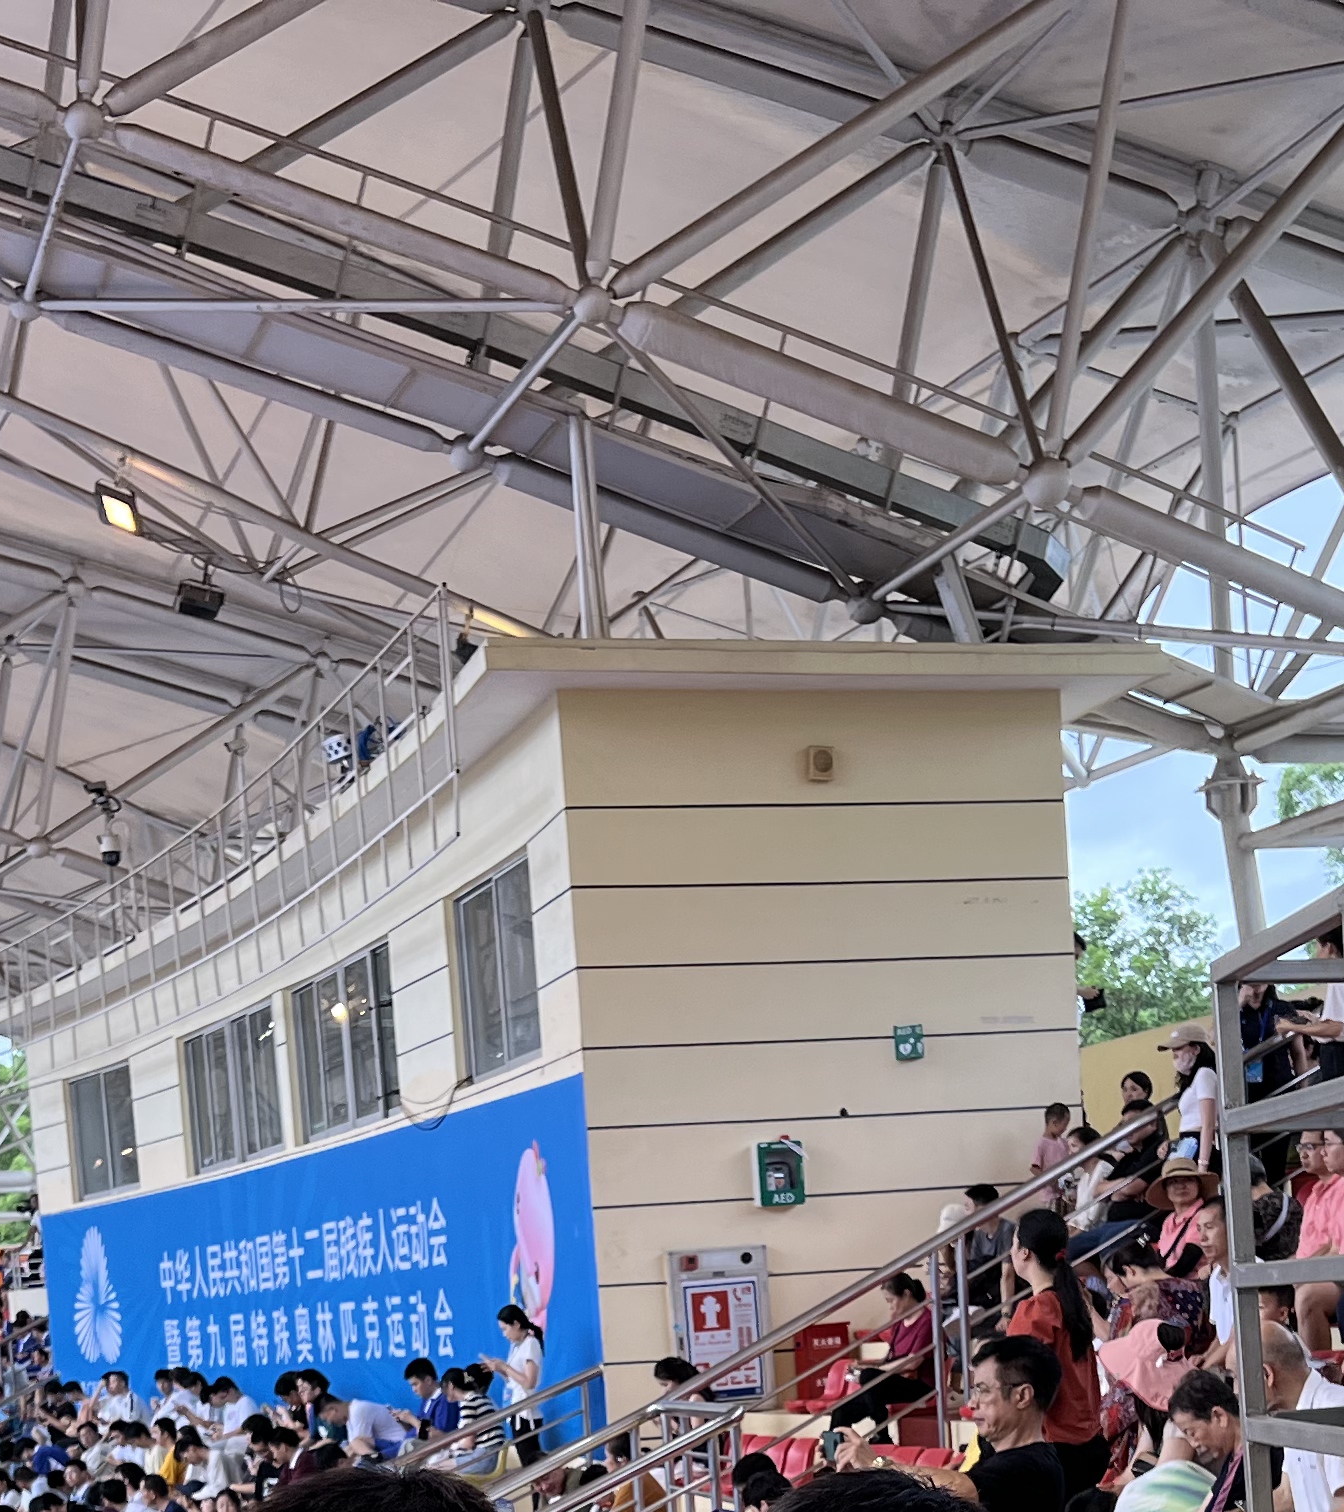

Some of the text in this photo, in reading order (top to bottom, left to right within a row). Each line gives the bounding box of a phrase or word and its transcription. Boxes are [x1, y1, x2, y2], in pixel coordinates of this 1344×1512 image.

[772, 1192, 795, 1204] AED
[159, 1197, 448, 1304] 中华人民共和国第十二届残疾人运动会
[163, 1288, 455, 1370] 暨第九届特殊奥林匹克运动会
